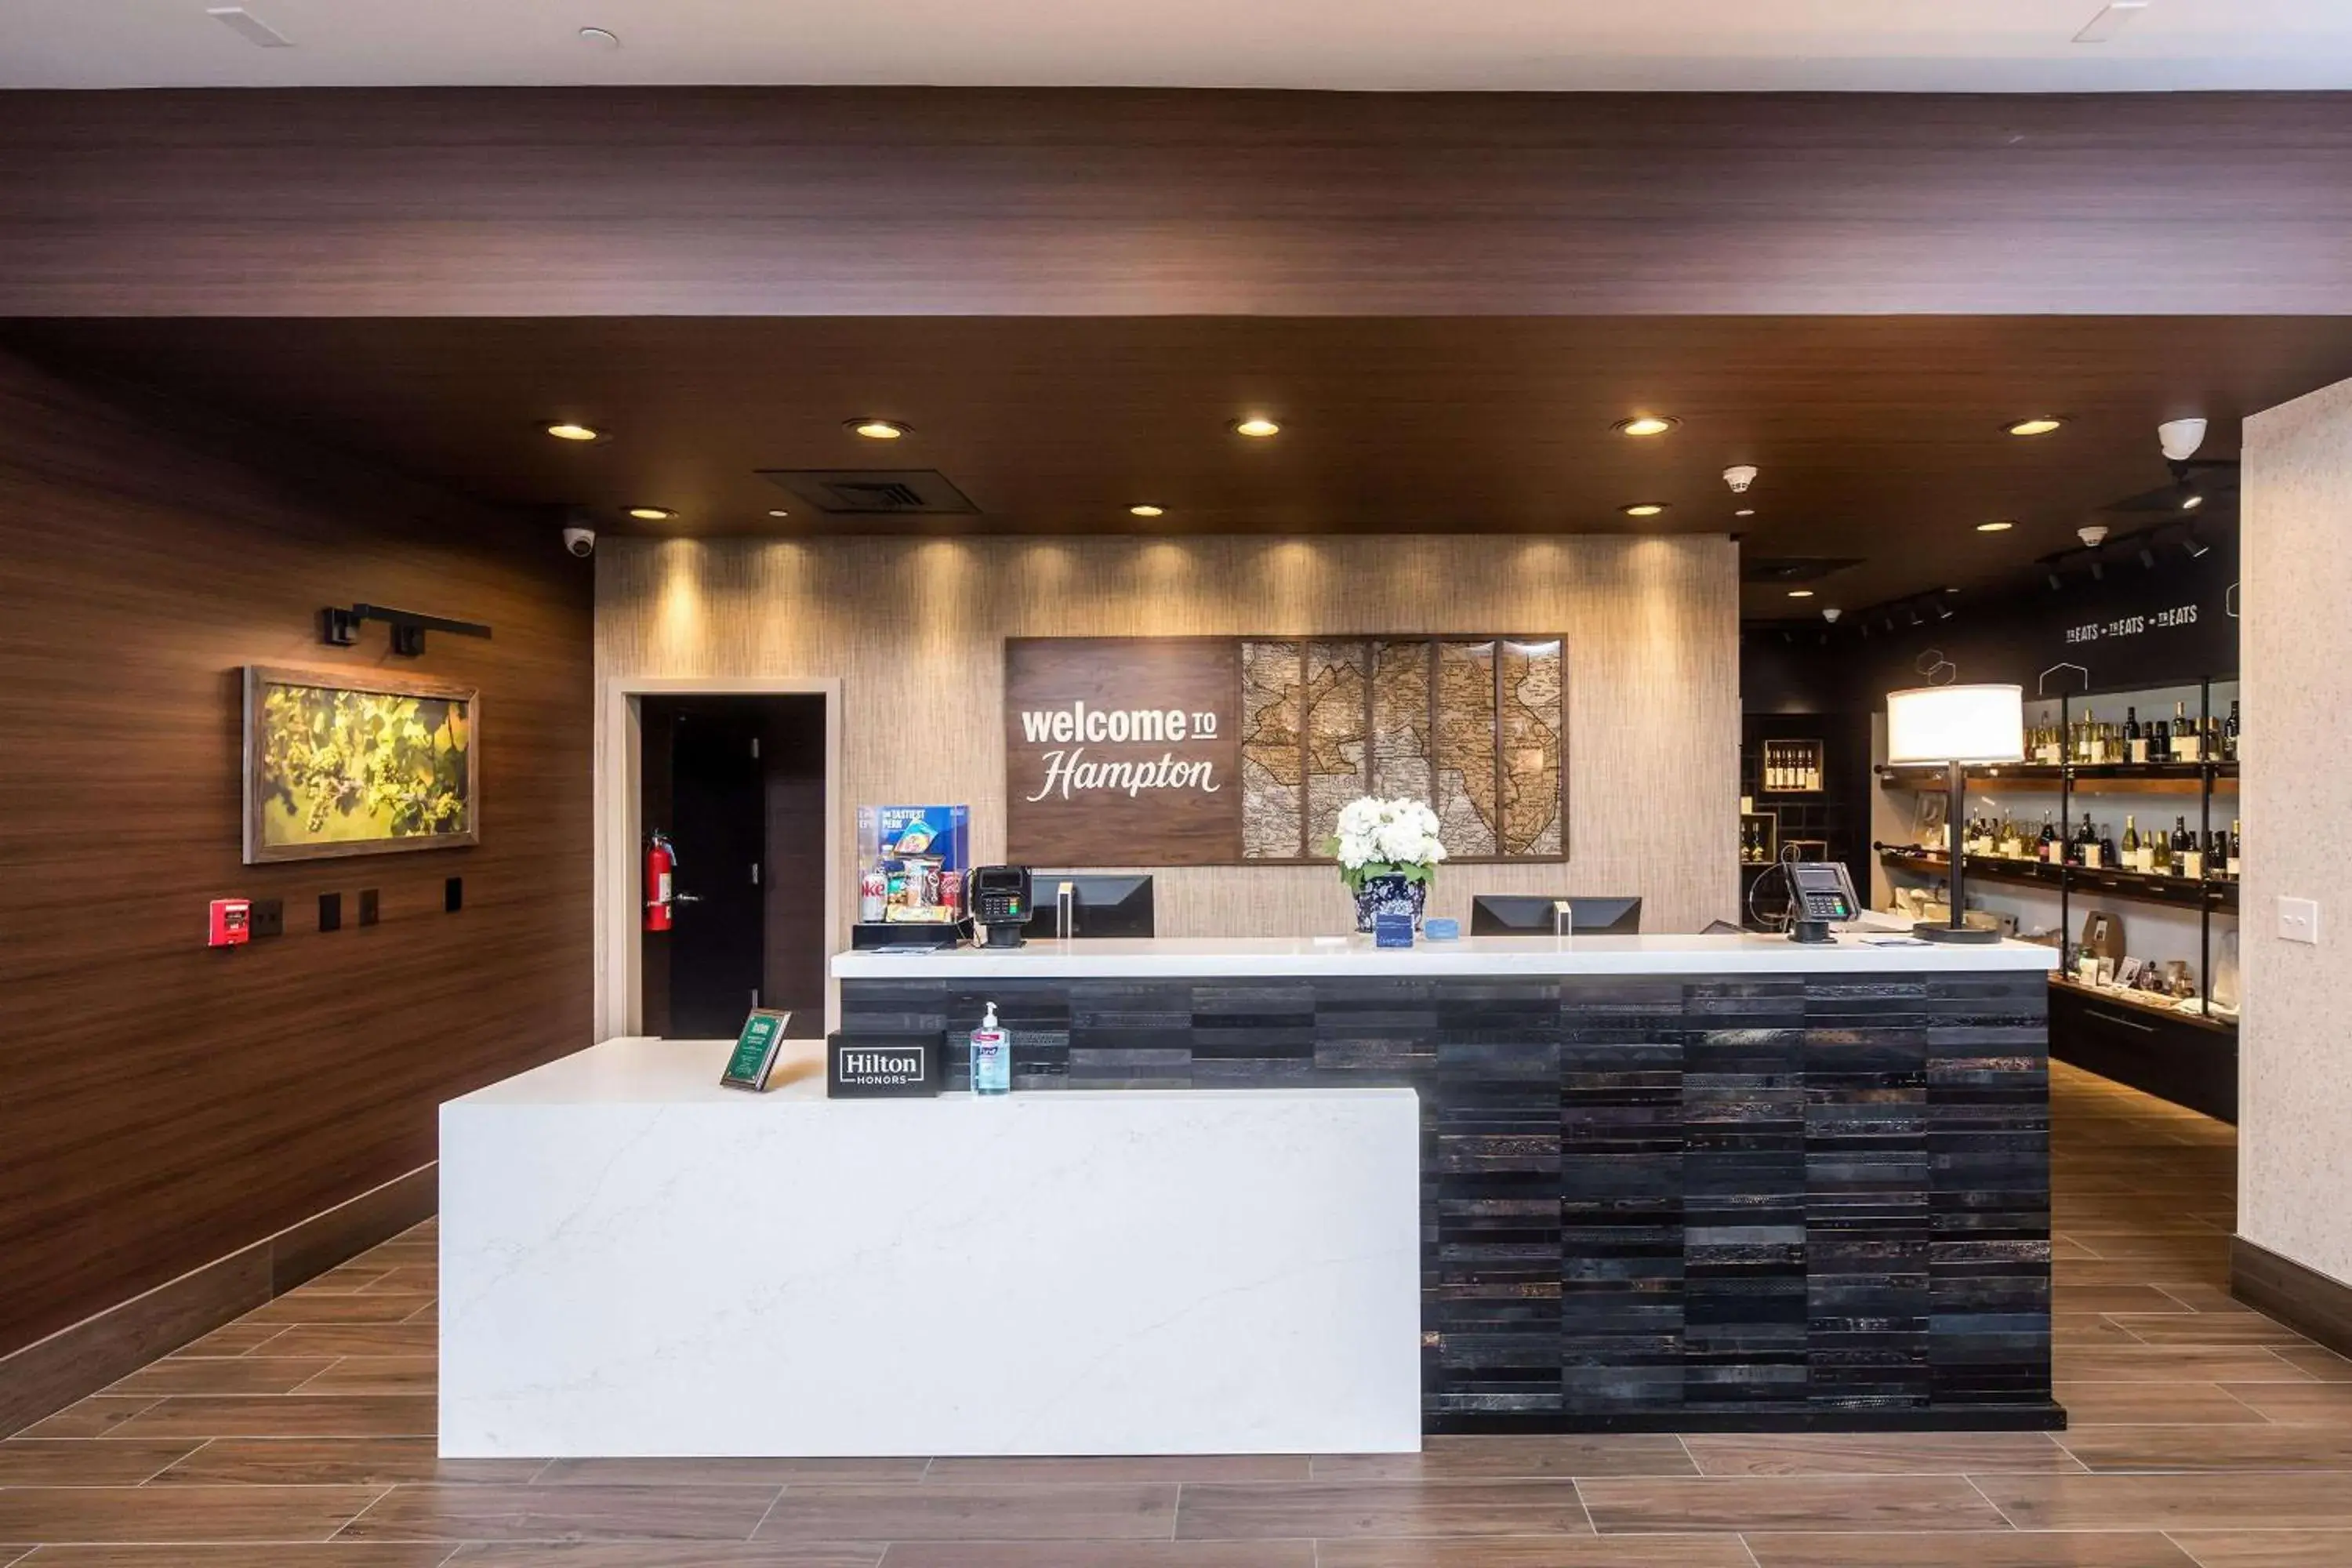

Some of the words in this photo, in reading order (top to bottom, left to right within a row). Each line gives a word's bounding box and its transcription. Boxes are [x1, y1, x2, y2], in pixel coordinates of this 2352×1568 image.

[1022, 700, 1187, 742] welcome
[1191, 712, 1217, 735] TO
[1026, 747, 1221, 802] Hampton
[846, 1054, 916, 1074] Hilton
[856, 1075, 907, 1084] HONORS
